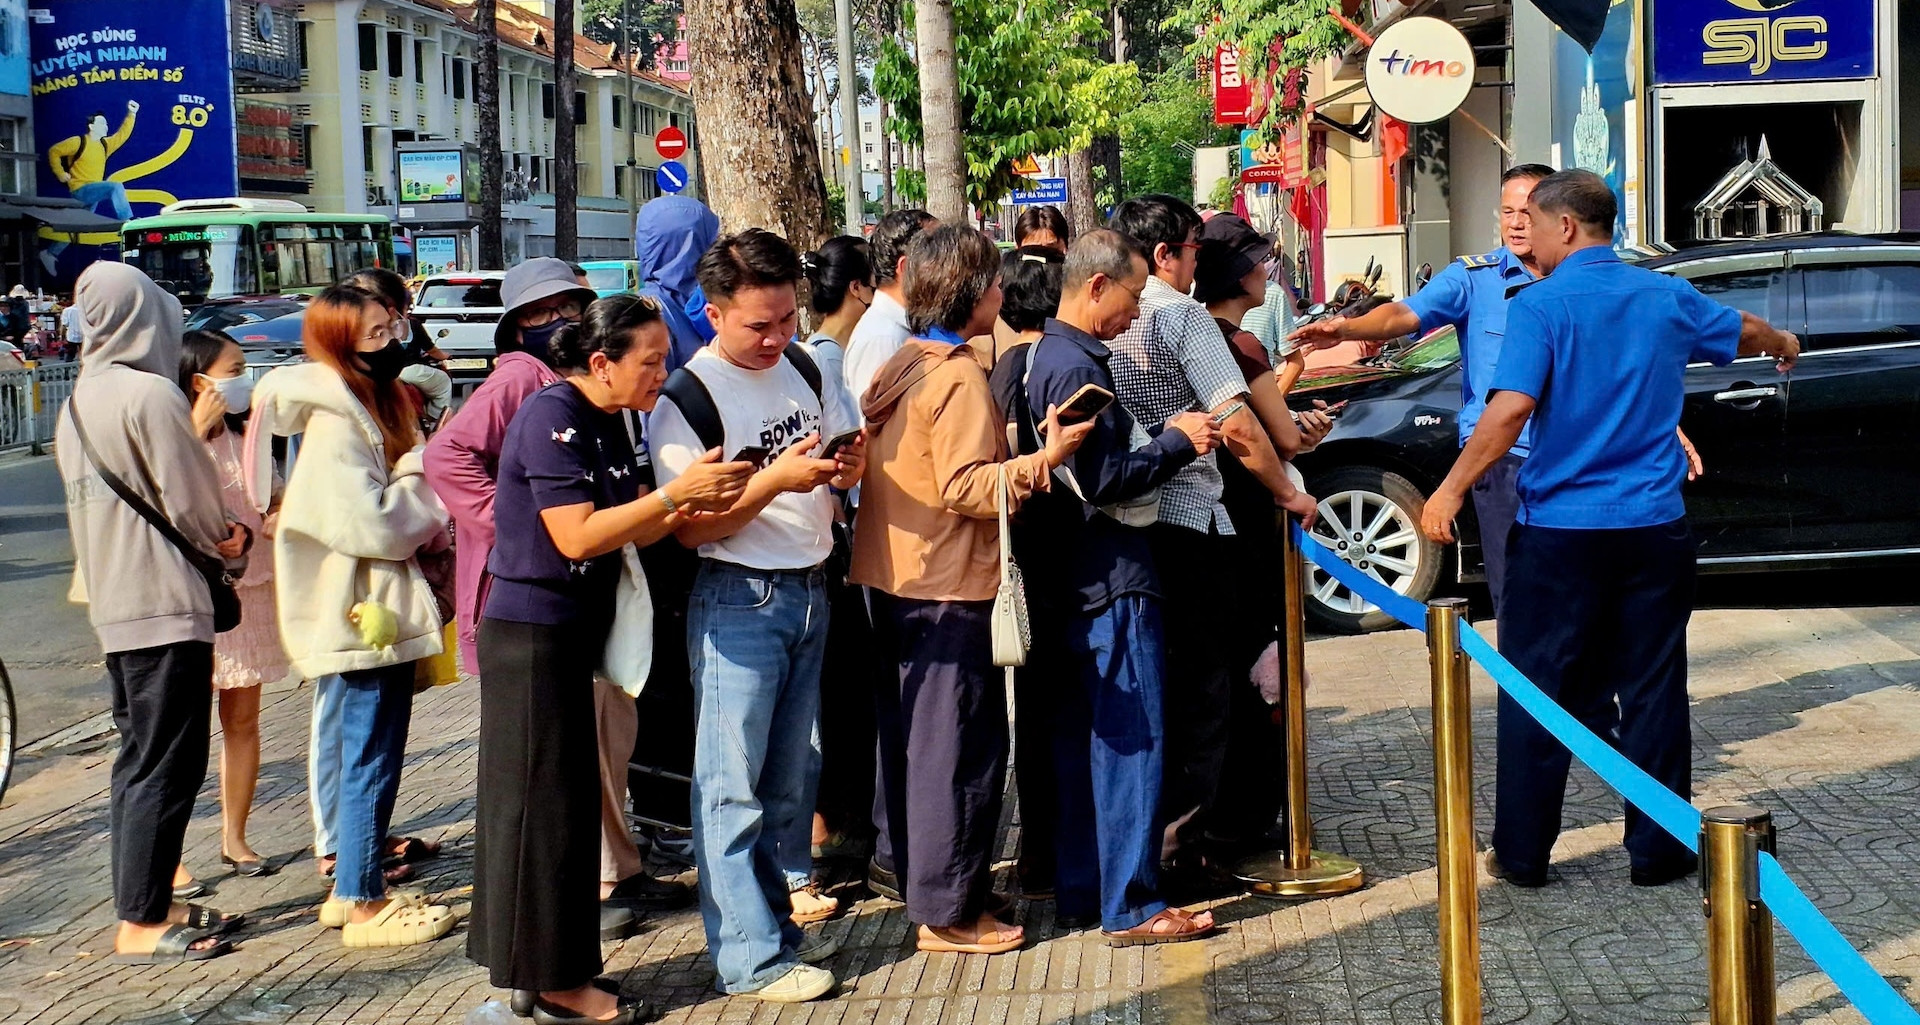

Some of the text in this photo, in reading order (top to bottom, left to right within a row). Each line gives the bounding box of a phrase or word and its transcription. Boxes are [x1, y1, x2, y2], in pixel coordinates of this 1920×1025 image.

[56, 26, 137, 51] HỌC ĐÚNG
[1702, 15, 1828, 76] SJC
[32, 46, 167, 76] LUYỆN NHANH
[120, 62, 159, 81] ĐIỂM
[163, 66, 185, 83] SỐ
[1379, 49, 1465, 77] timo
[178, 94, 206, 105] IELTS
[760, 410, 802, 451] BOW
